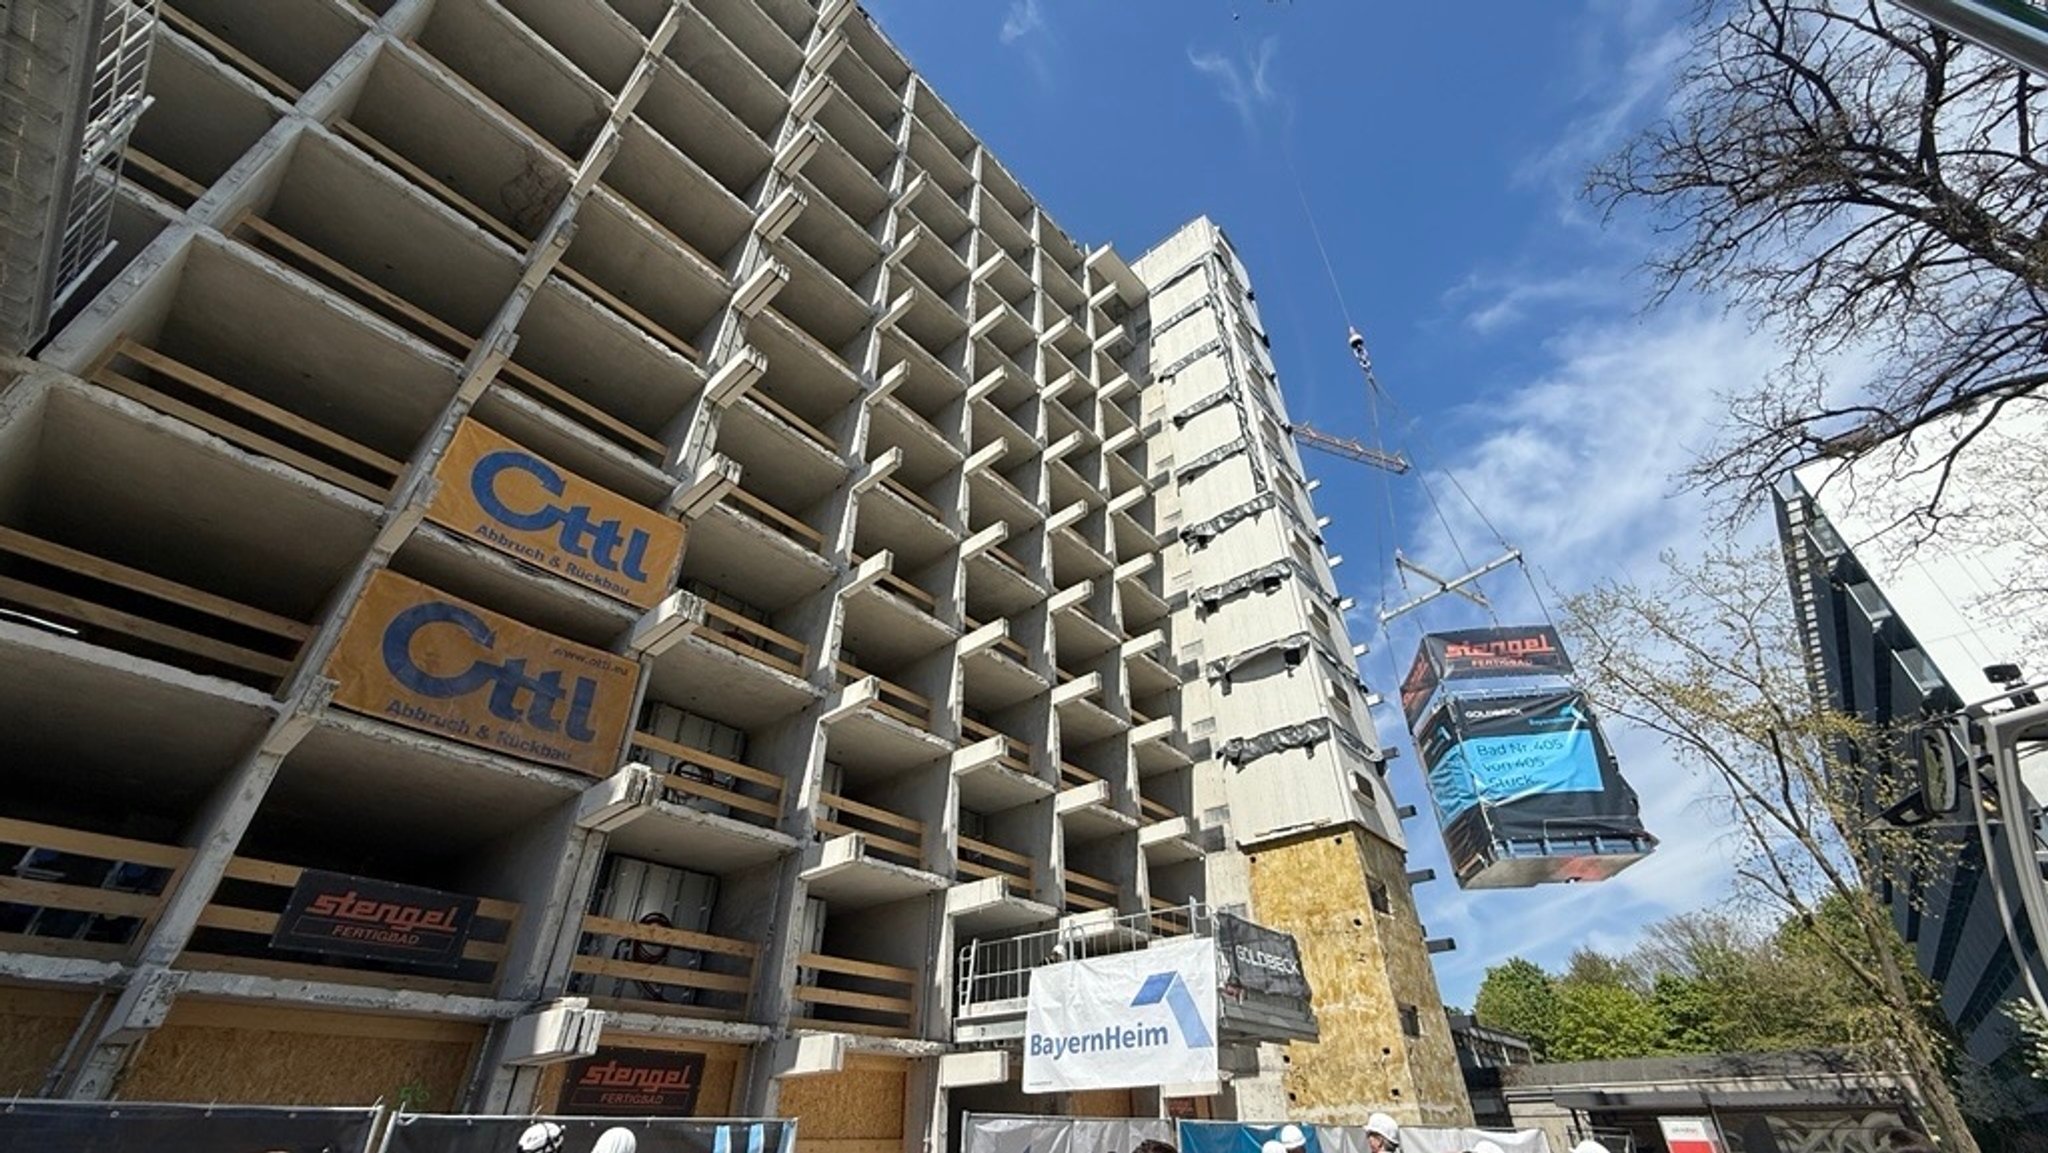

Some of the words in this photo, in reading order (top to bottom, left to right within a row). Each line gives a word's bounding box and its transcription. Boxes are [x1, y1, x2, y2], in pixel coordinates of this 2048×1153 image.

[475, 524, 544, 561] Abbruch
[549, 554, 561, 568] &
[1445, 633, 1556, 659] stengel
[385, 698, 470, 734] Abbruch
[475, 724, 490, 740] &
[1476, 743, 1508, 757] Bad
[304, 891, 457, 934] stengel
[331, 924, 420, 946] FERTIGBAD
[1235, 943, 1300, 976] GOLDBECK
[1030, 1022, 1169, 1060] BayernHeim
[578, 1061, 691, 1094] stengel
[600, 1092, 664, 1105] FERTIGBAD
